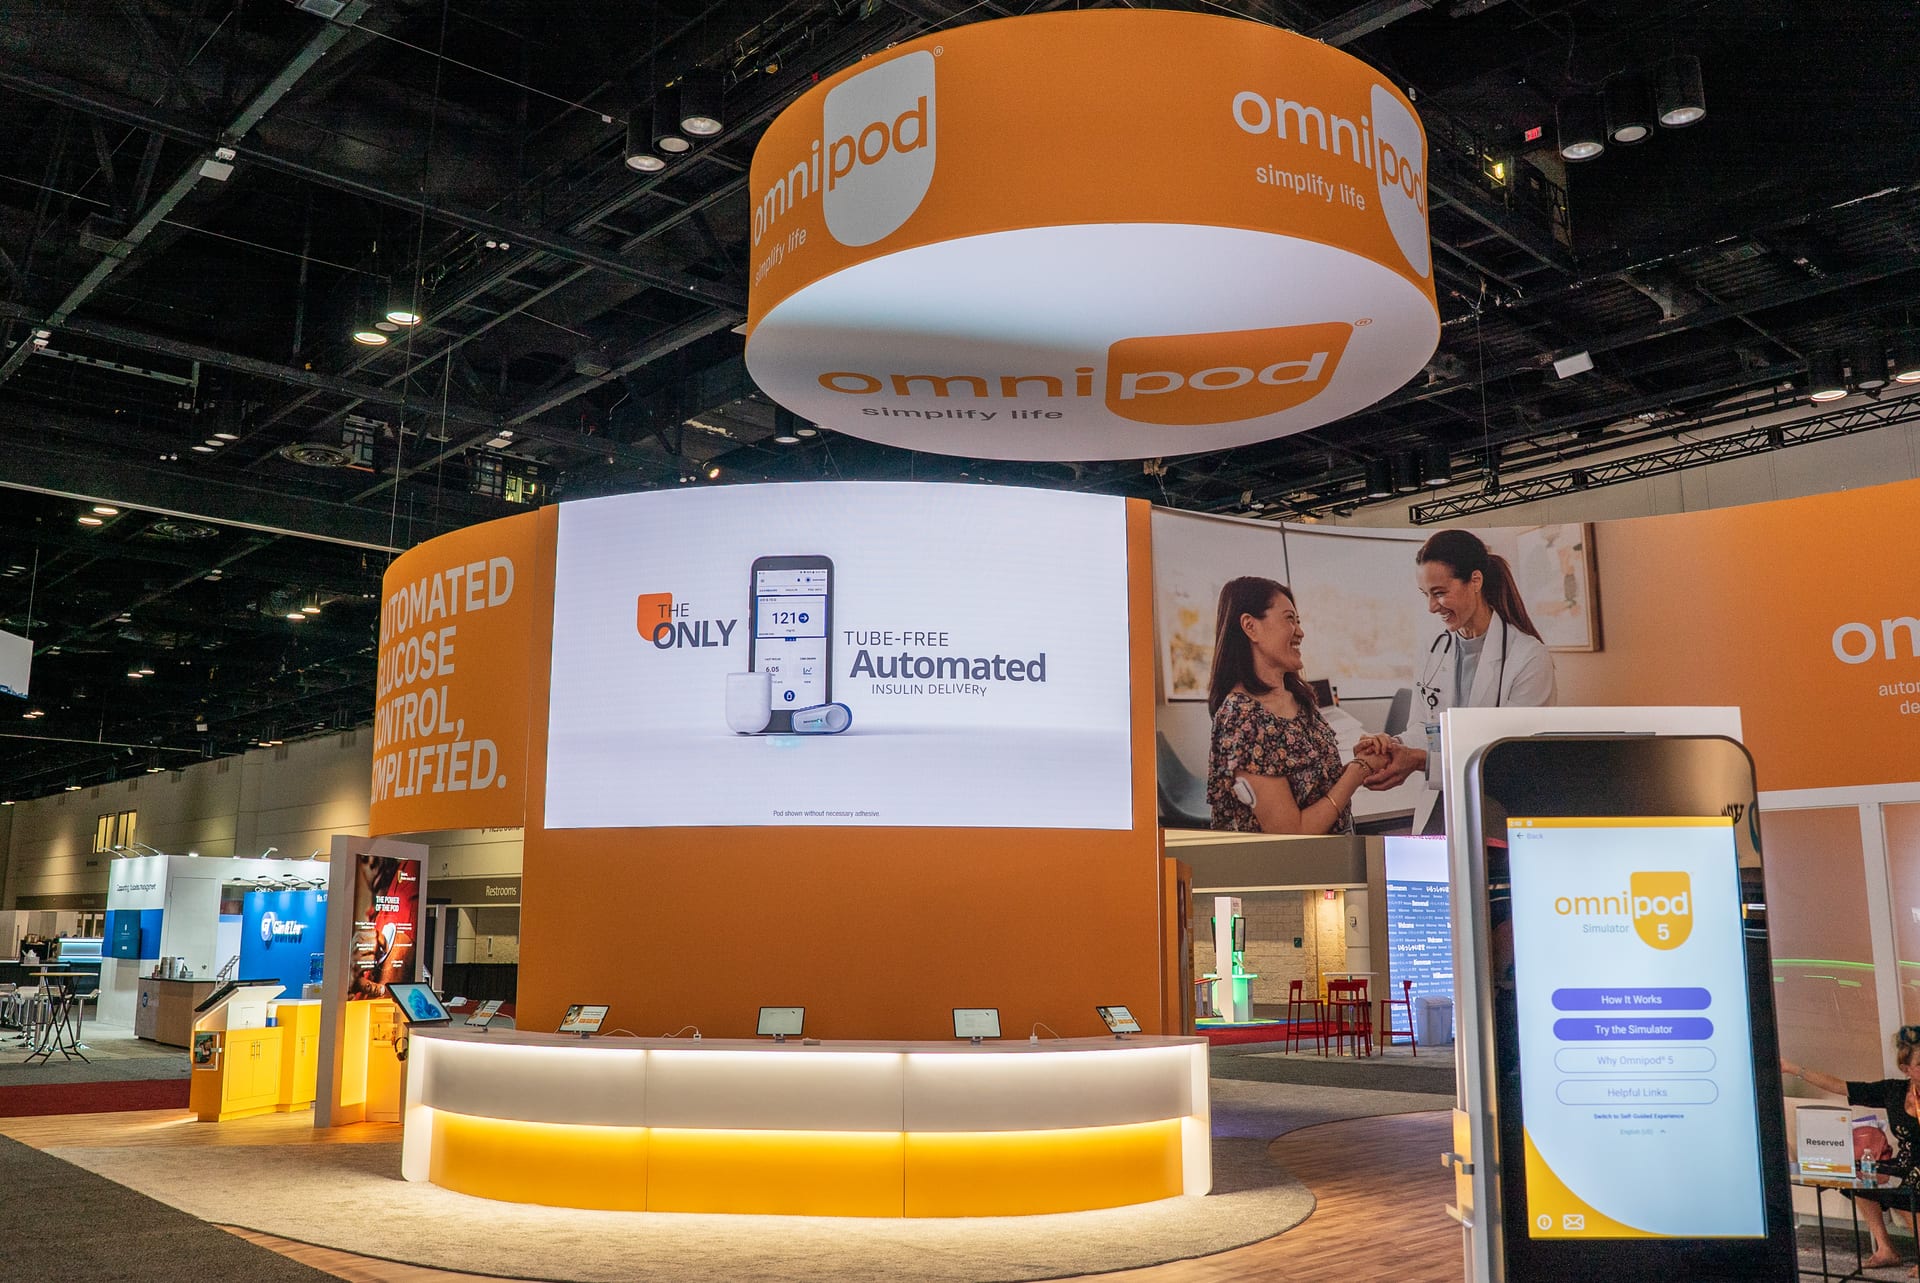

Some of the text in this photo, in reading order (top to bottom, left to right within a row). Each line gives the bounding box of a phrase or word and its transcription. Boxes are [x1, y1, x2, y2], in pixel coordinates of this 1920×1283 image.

[754, 95, 928, 247] omnipod
[1256, 163, 1366, 211] simplify life
[788, 228, 807, 253] life
[818, 351, 1329, 400] omnipod
[861, 406, 1064, 422] simplify life
[657, 602, 690, 618] THE
[772, 612, 796, 625] 121
[653, 619, 738, 650] ONLY
[843, 630, 949, 647] TUBE-FREE
[849, 649, 1047, 683] Automated
[871, 683, 987, 697] INSULIN DELIVERY
[773, 809, 784, 817] Pod
[826, 810, 854, 818] necessary
[485, 885, 517, 897] Restrooms
[1554, 890, 1689, 919] omnipod
[1582, 923, 1630, 934] Simulator
[1657, 924, 1670, 941] 5
[1601, 994, 1663, 1004] How It Works
[1594, 1024, 1673, 1037] Try the Simulator
[1597, 1056, 1617, 1067] Why
[1668, 1056, 1674, 1065] 5
[1607, 1087, 1668, 1098] Helpful Links
[1654, 1113, 1685, 1121] Experience
[1806, 1138, 1845, 1148] Reserved
